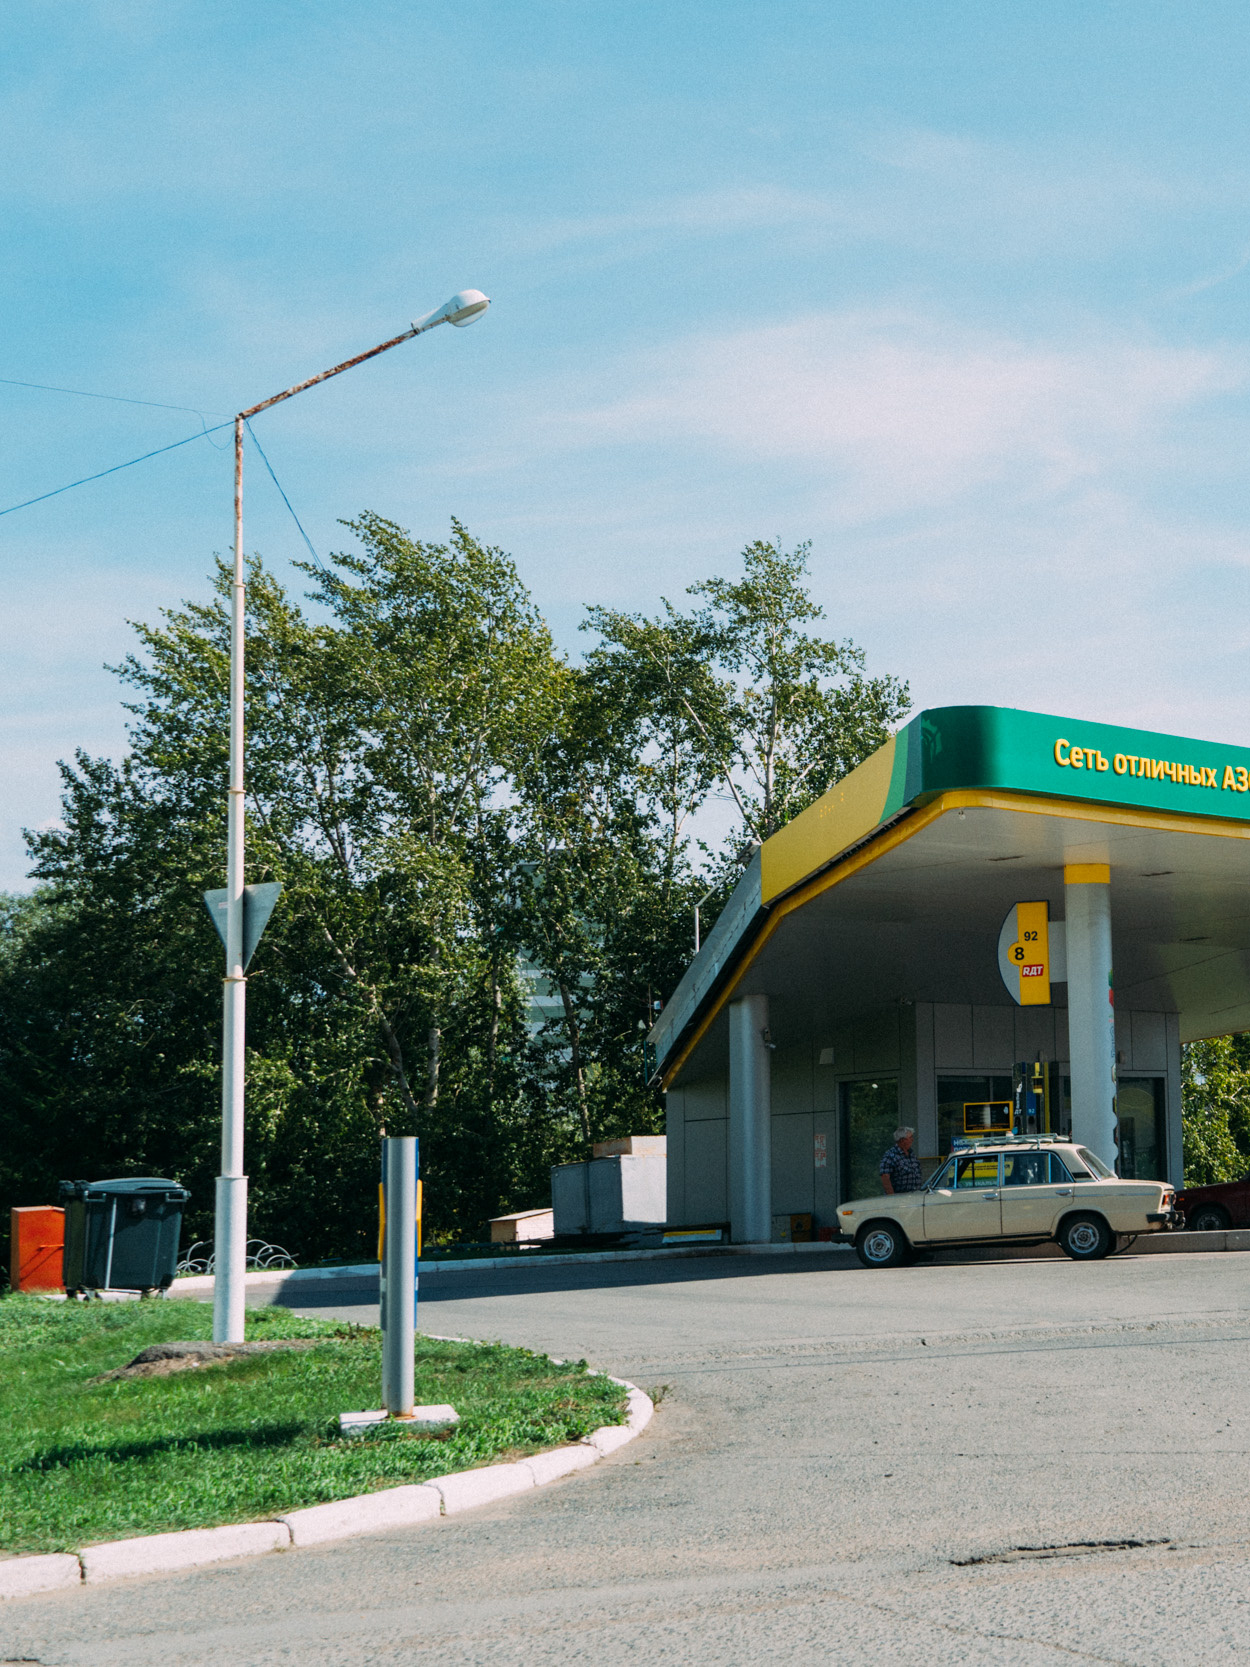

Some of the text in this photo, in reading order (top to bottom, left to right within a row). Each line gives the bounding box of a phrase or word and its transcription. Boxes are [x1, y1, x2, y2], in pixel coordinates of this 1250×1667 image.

[1054, 738, 1110, 772] Сеть
[1113, 753, 1218, 788] отличных
[1024, 931, 1038, 941] 92
[1014, 947, 1025, 960] 8
